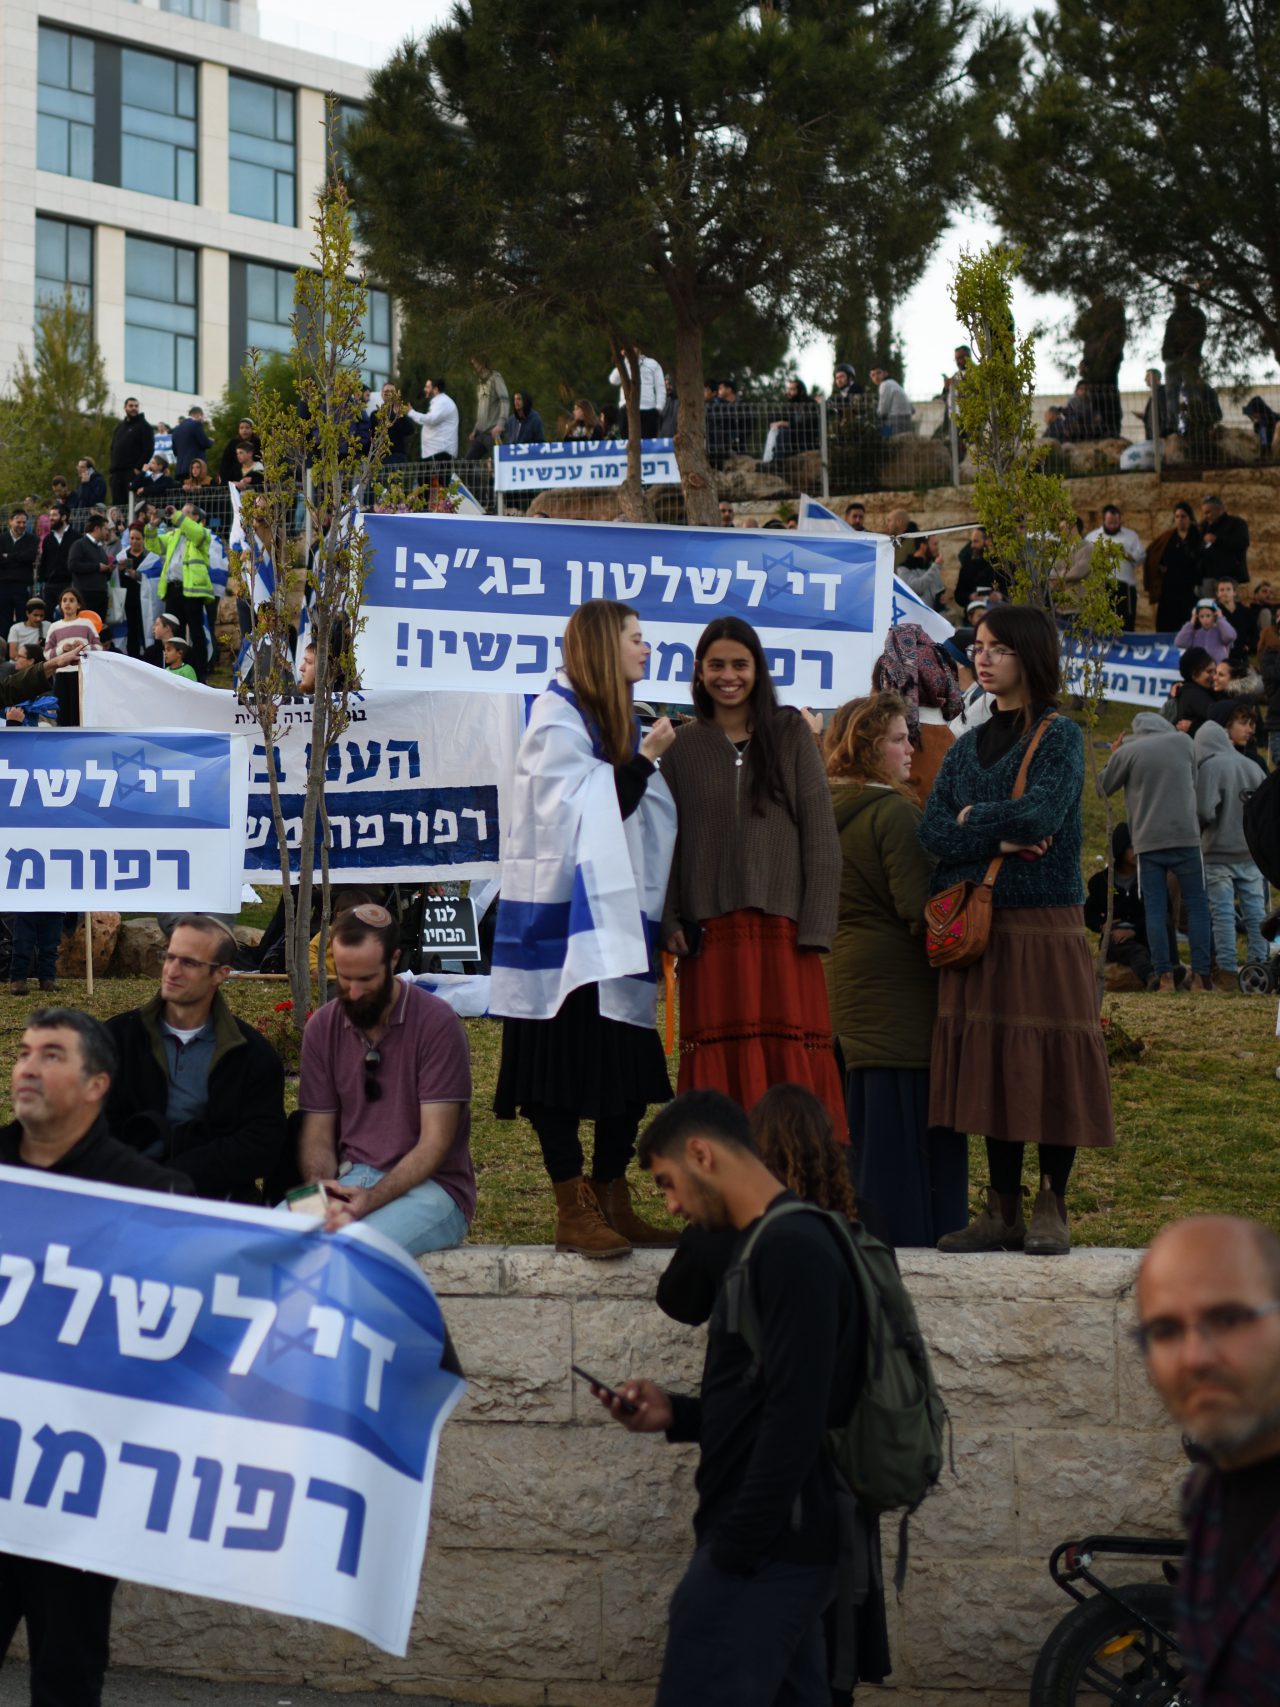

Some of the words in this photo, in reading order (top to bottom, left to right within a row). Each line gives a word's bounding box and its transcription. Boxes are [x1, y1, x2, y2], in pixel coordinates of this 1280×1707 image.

[511, 464, 583, 482] עכשיו!
[590, 460, 670, 479] רפמה
[395, 546, 546, 596] בג"צ!
[566, 556, 768, 607] לשלטון
[787, 572, 842, 611] די
[643, 641, 834, 690] רפמ
[284, 711, 313, 723] ברה
[138, 769, 196, 808] די
[329, 807, 487, 849] רפורמה
[434, 905, 457, 922] לנו
[308, 1304, 397, 1413] די
